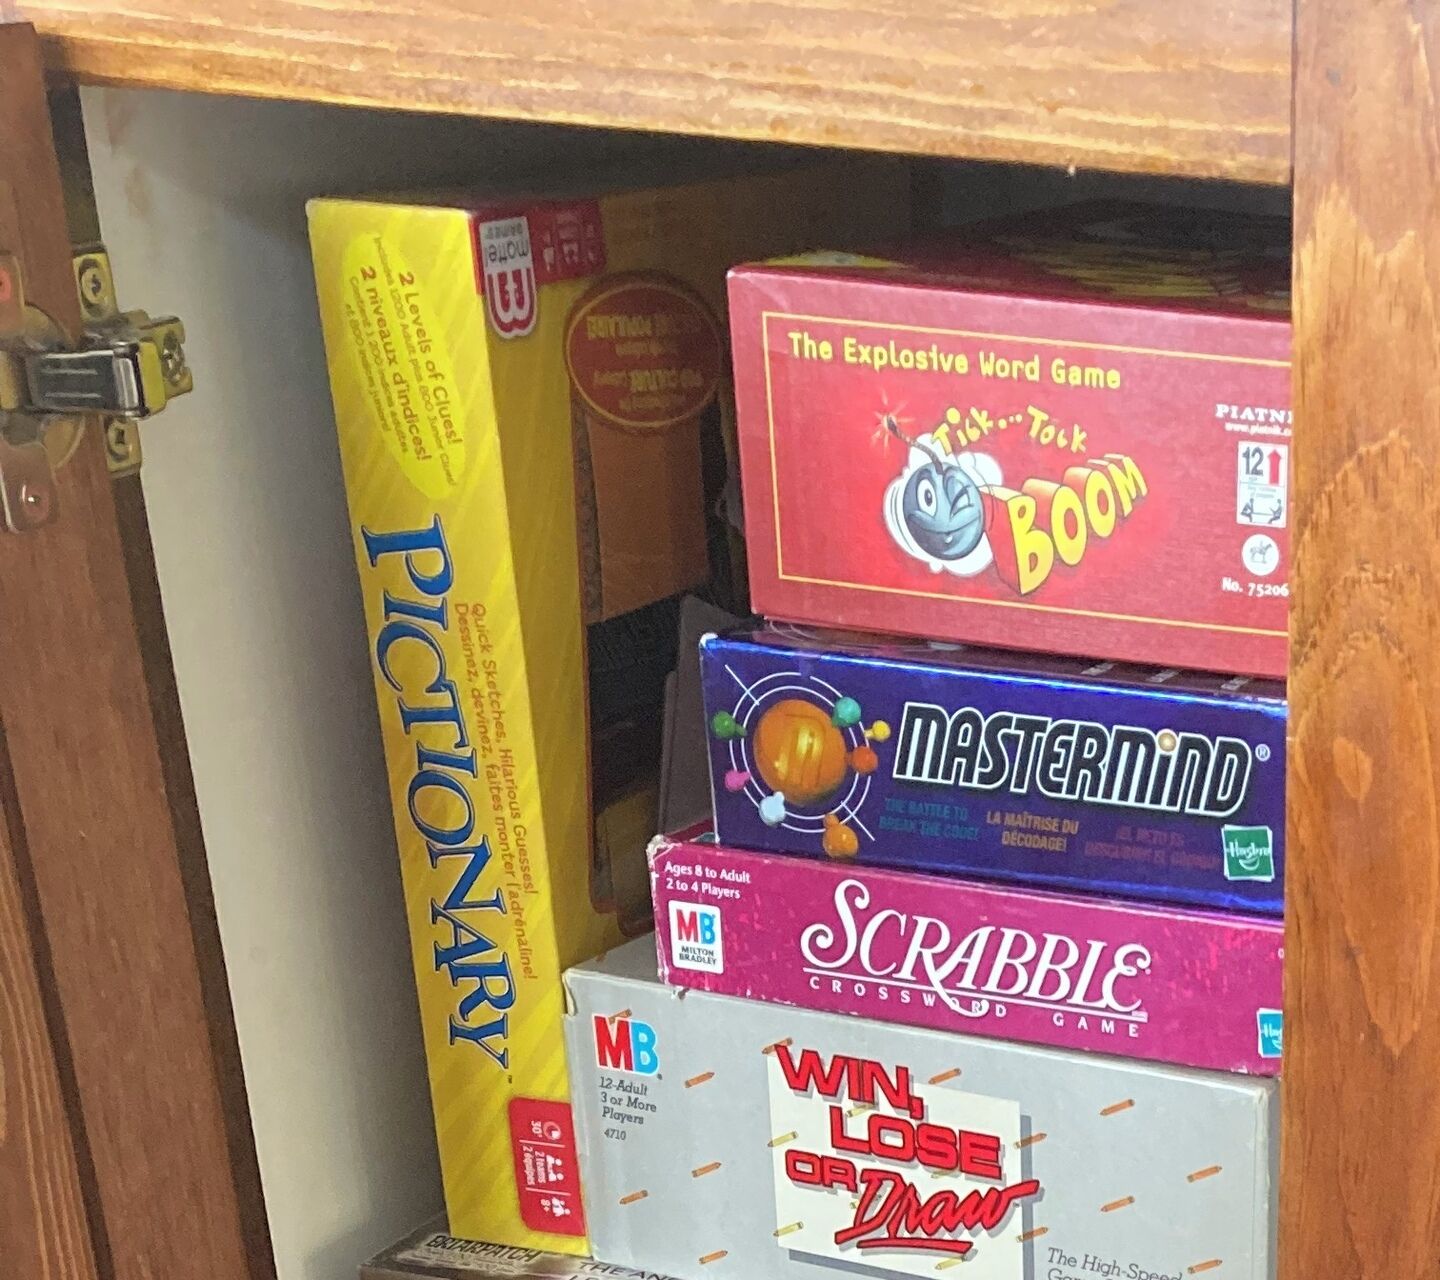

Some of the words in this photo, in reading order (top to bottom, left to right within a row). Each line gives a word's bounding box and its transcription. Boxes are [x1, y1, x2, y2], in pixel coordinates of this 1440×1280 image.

[404, 292, 432, 354] Levels
[366, 287, 398, 366] niveaux
[393, 372, 432, 461] d'indices!
[425, 360, 445, 380] of
[788, 330, 832, 361] The
[843, 337, 969, 375] Explosive
[979, 350, 1041, 383] Word
[1051, 358, 1122, 390] Game
[433, 386, 463, 445] Clues!
[1242, 446, 1264, 476] 12
[1004, 454, 1149, 596] BOOM
[1222, 577, 1243, 592] No.
[1248, 582, 1290, 597] 75206
[470, 602, 491, 651] Quick
[498, 748, 521, 820] Hilarious
[513, 824, 539, 895] Guesses!
[360, 513, 517, 1070] PICTIONARY
[455, 602, 478, 684] Dessinez,
[472, 687, 493, 758] devinez,
[486, 763, 502, 815] faites
[495, 817, 517, 879] monter
[508, 880, 539, 981] l'adrénaline!
[1003, 810, 1059, 833] MAÎTRISE
[1002, 830, 1067, 852] DÉCODAGE!
[1228, 838, 1270, 860] Hasbro
[664, 860, 693, 878] Ages
[704, 865, 718, 879] to
[720, 868, 750, 884] Adult
[666, 878, 674, 890] 2
[675, 878, 689, 891] to
[691, 880, 699, 892] 4
[701, 882, 741, 899] Players
[676, 908, 716, 946] MB
[679, 952, 718, 966] BRADLEY
[681, 945, 715, 957] MILTON
[800, 879, 1152, 1018] SCRABBLE
[810, 975, 1007, 1018] CROSSWORD
[1053, 1011, 1140, 1038] GAME
[592, 1013, 660, 1076] MB
[599, 1076, 648, 1096] 12-Adult
[774, 1044, 924, 1119] WIN,
[602, 1106, 645, 1124] Players
[610, 1097, 624, 1106] or
[626, 1096, 657, 1112] More
[604, 1128, 627, 1140] 4710
[829, 1105, 1002, 1180] LOSE
[784, 1148, 858, 1193] OR
[834, 1168, 1040, 1247] Draw
[579, 1260, 620, 1275] THE
[1047, 1247, 1078, 1268] The
